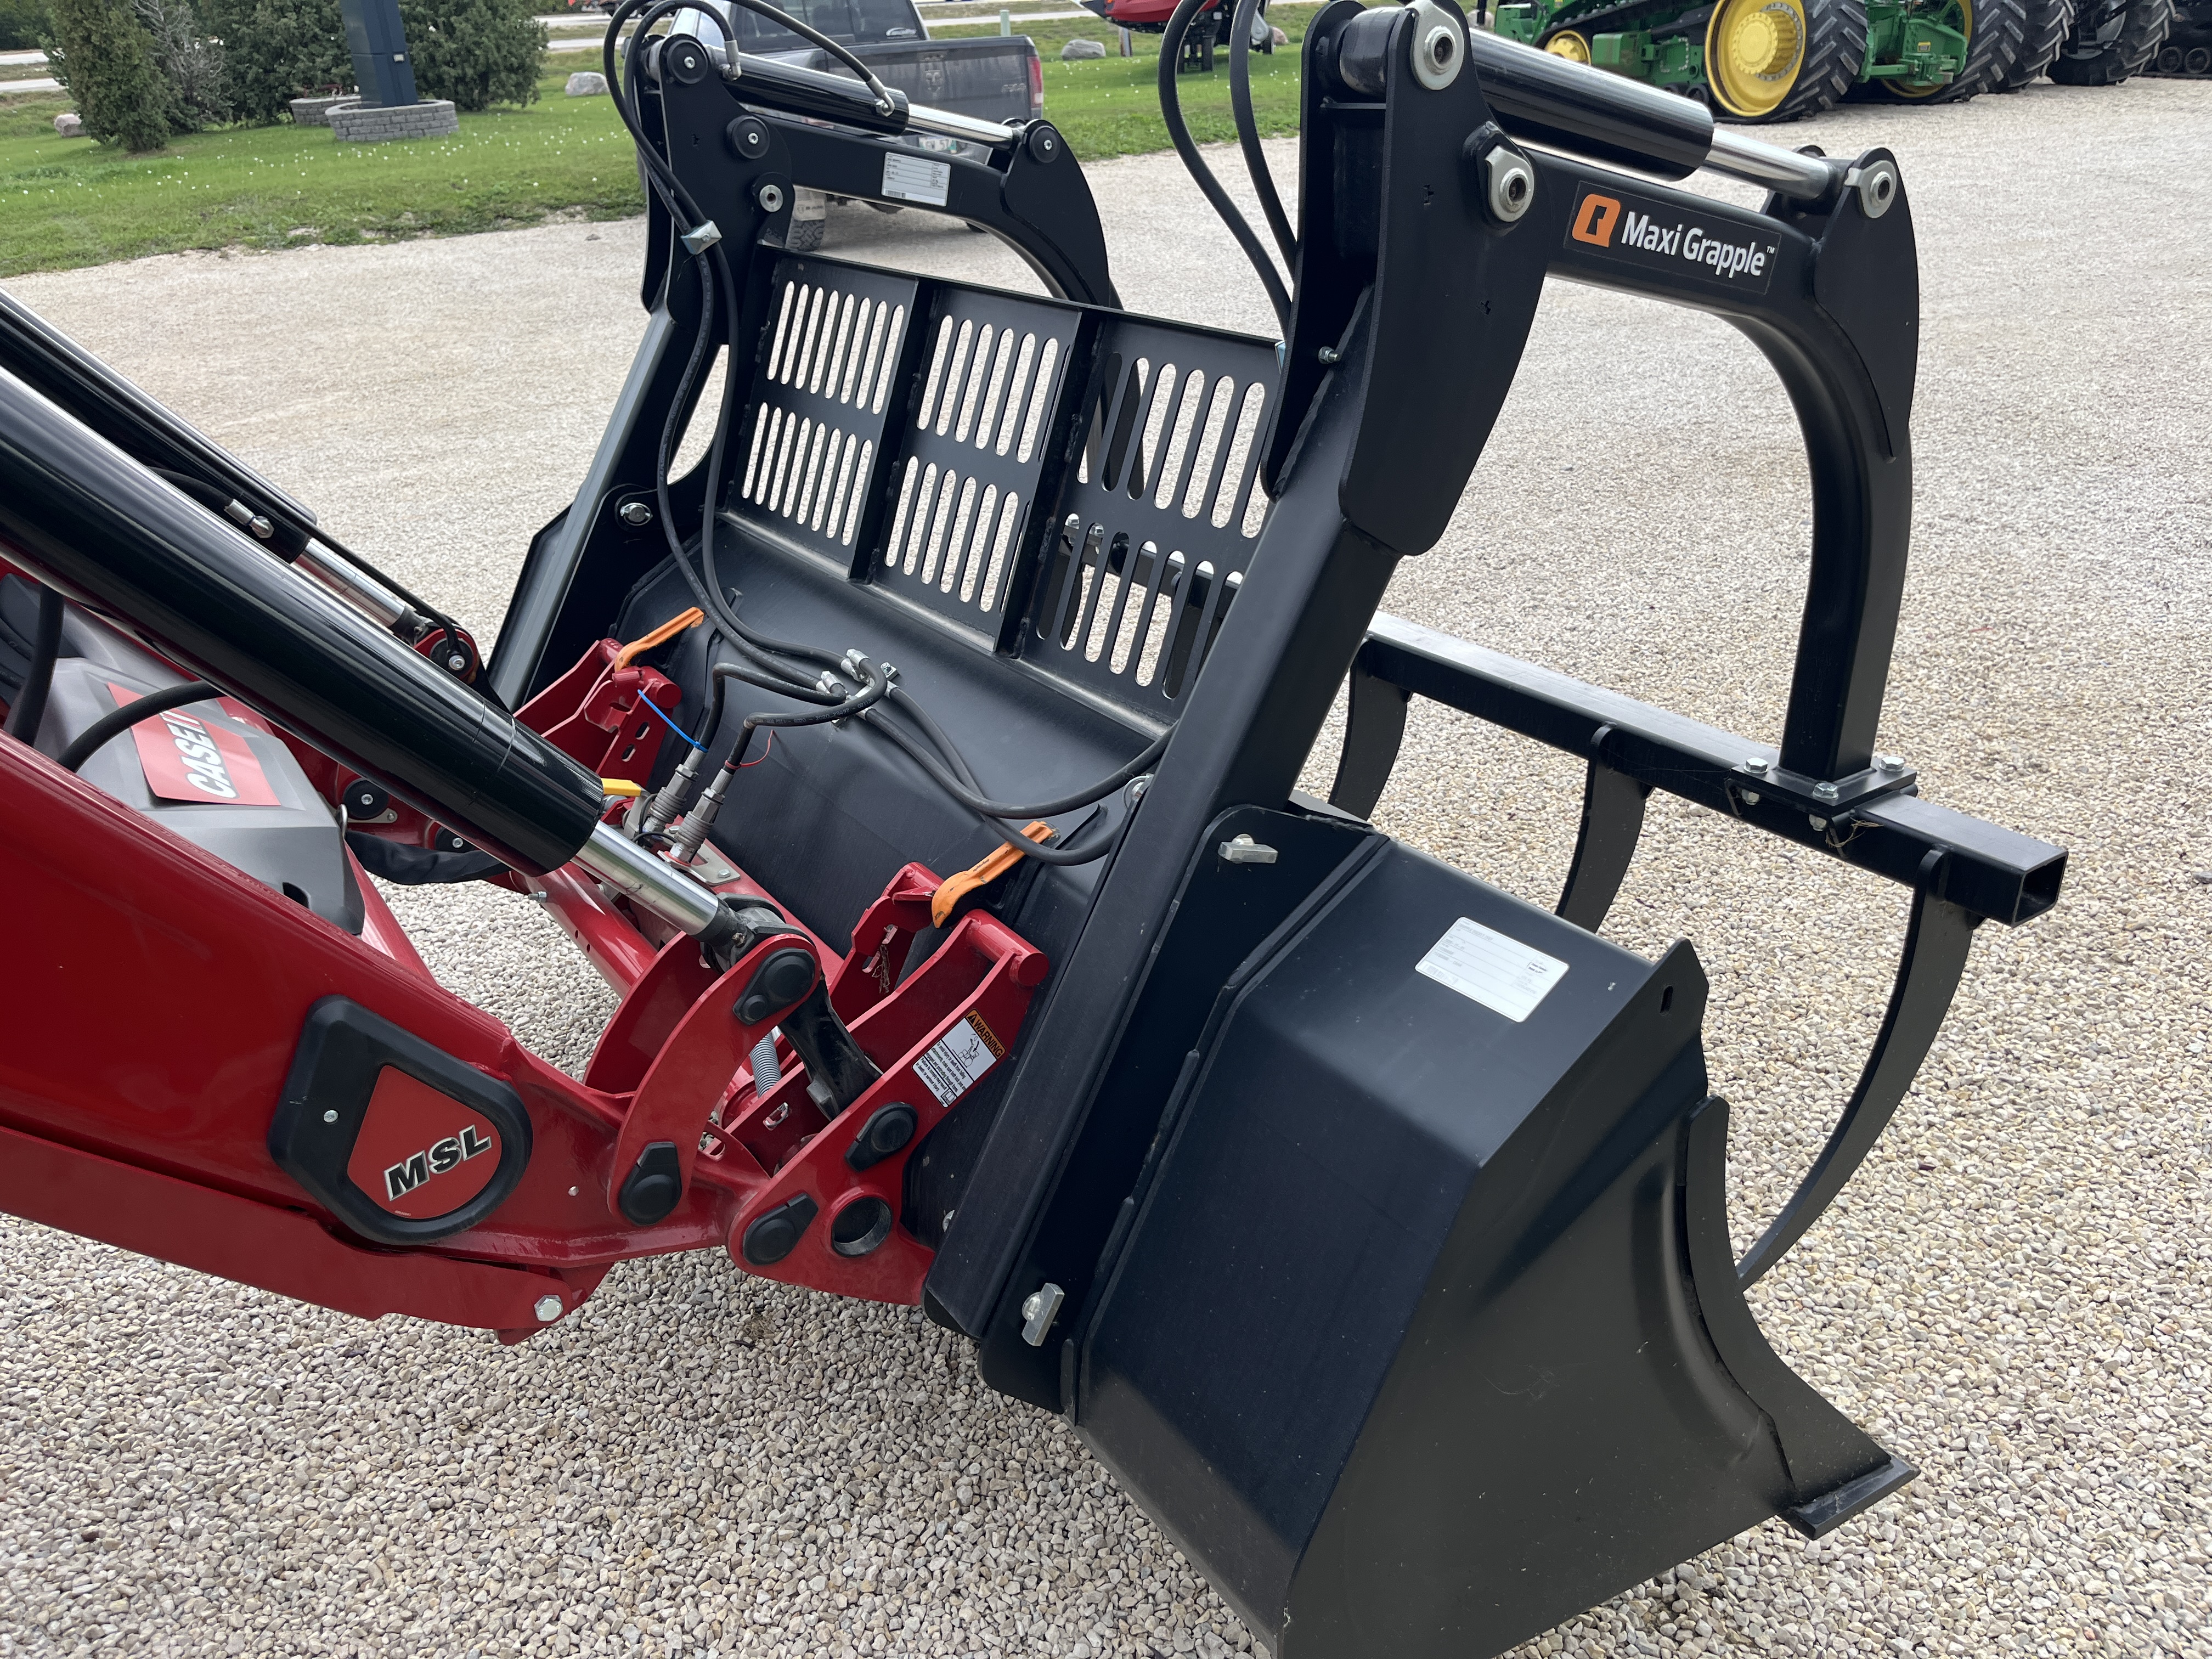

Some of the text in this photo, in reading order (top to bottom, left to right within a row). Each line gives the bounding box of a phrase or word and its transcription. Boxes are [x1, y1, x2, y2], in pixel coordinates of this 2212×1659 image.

[1621, 211, 1683, 256] Maxi
[1683, 227, 1765, 278] Grapple
[974, 1019, 1003, 1058] WARNING
[383, 1125, 492, 1201] MSL
